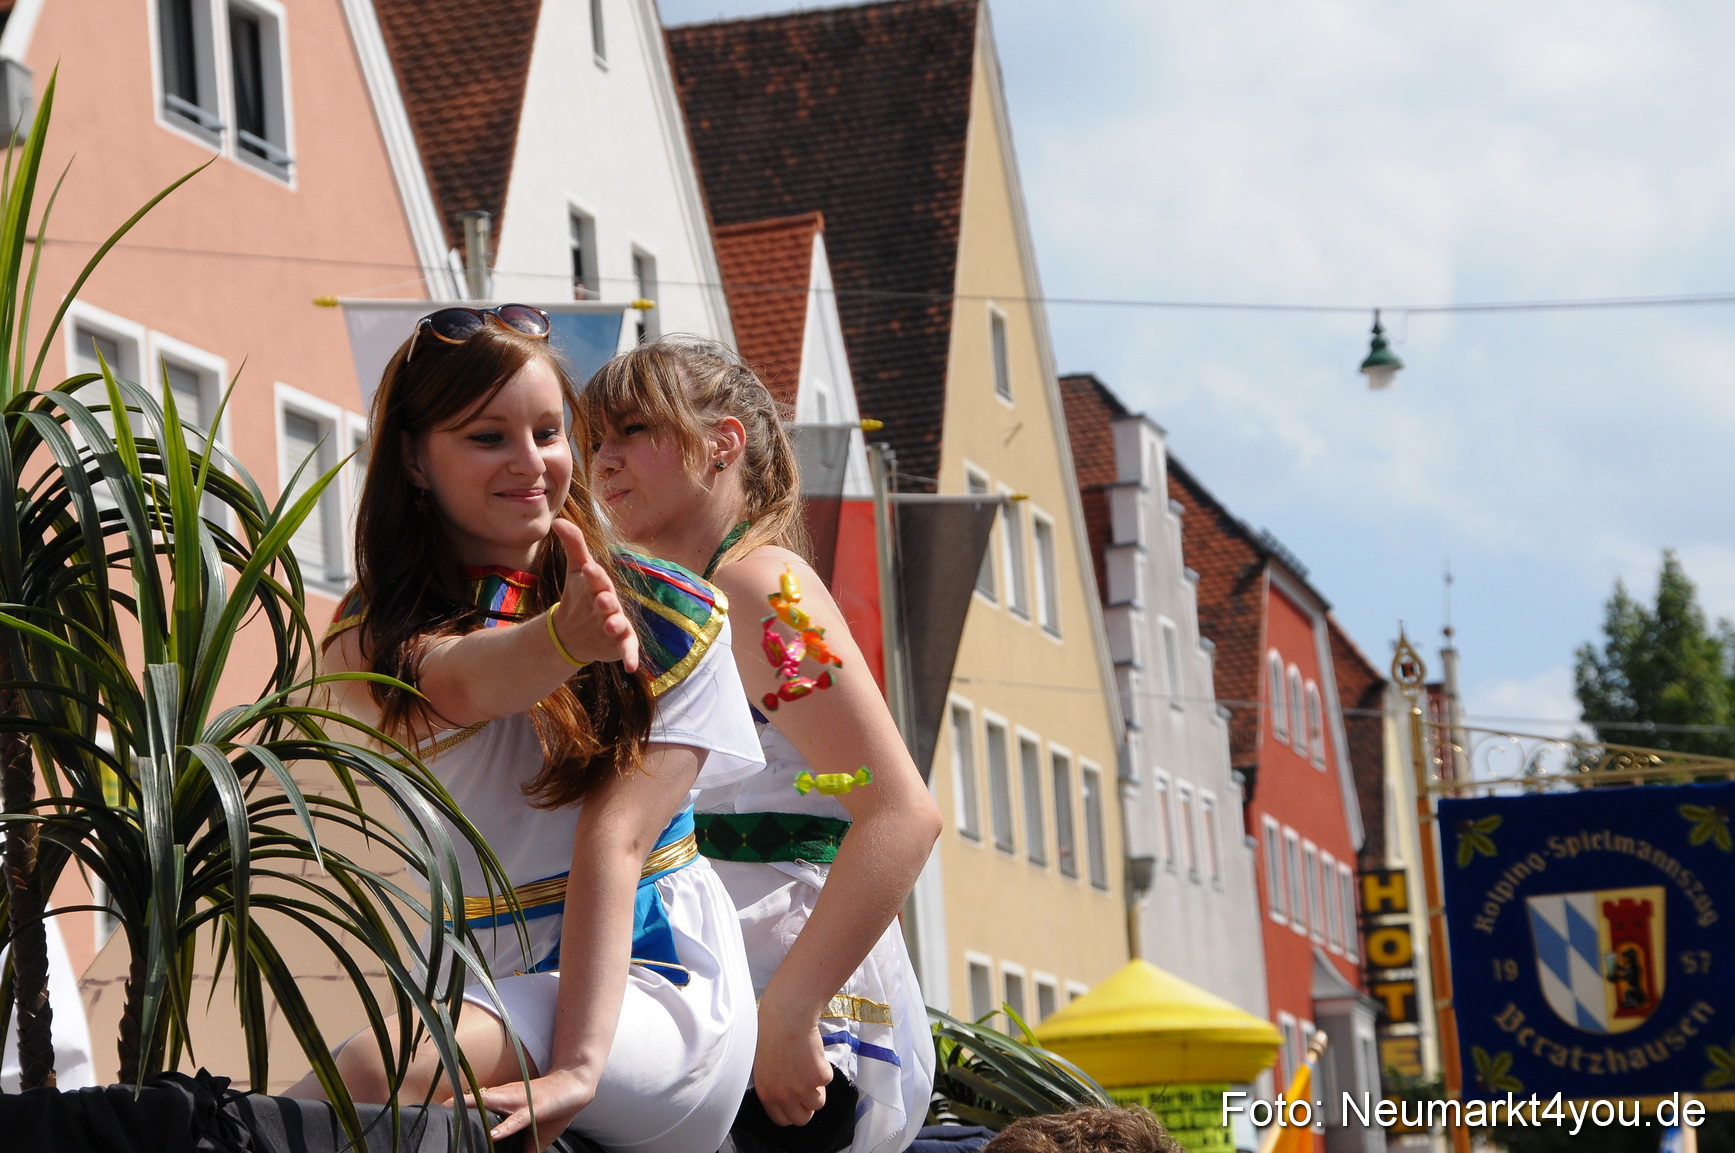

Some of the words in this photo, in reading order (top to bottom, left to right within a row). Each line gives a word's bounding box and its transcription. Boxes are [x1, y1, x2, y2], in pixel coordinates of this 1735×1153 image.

[1474, 830, 1719, 935] Kolping-Spielmannszug
[1493, 958, 1519, 982] 19
[1680, 951, 1712, 975] 57
[1495, 999, 1715, 1075] Beratzhausen
